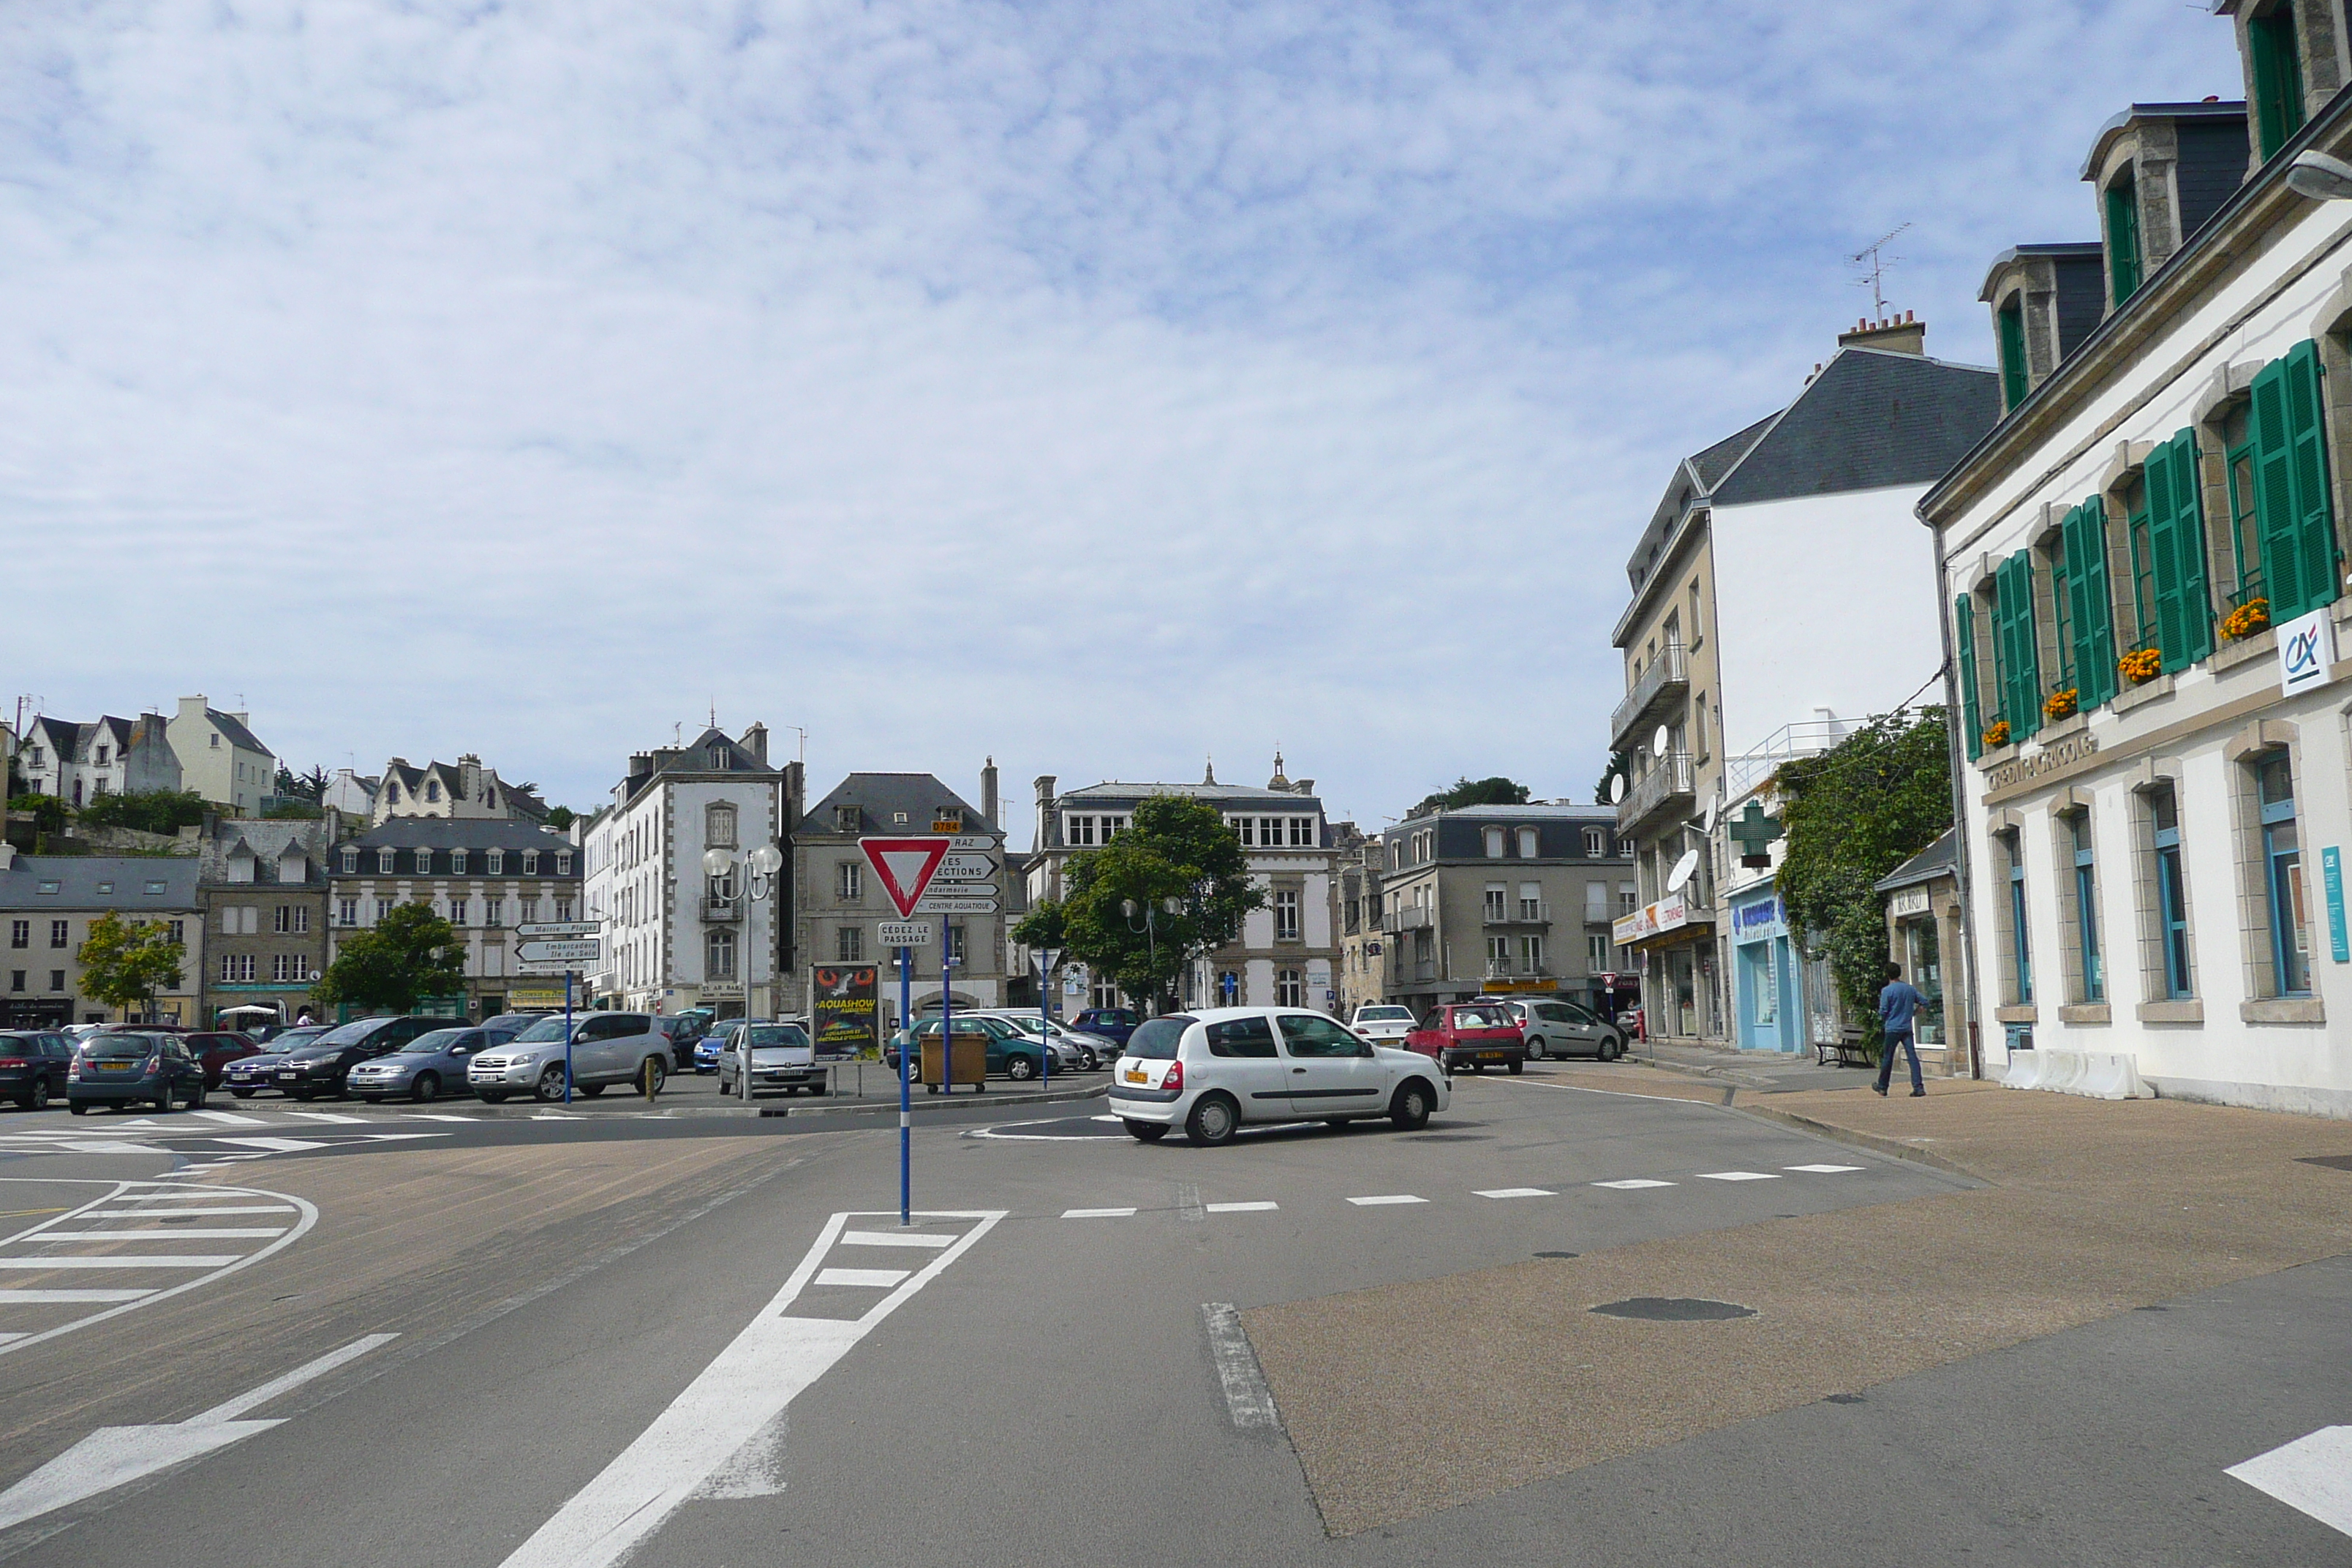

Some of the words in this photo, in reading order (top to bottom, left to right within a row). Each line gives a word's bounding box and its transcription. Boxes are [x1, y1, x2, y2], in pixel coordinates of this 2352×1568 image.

[933, 823, 957, 831] D784
[954, 839, 975, 847] RAZ
[938, 868, 981, 876] ECTIONS
[882, 926, 913, 934] CÉDEZ
